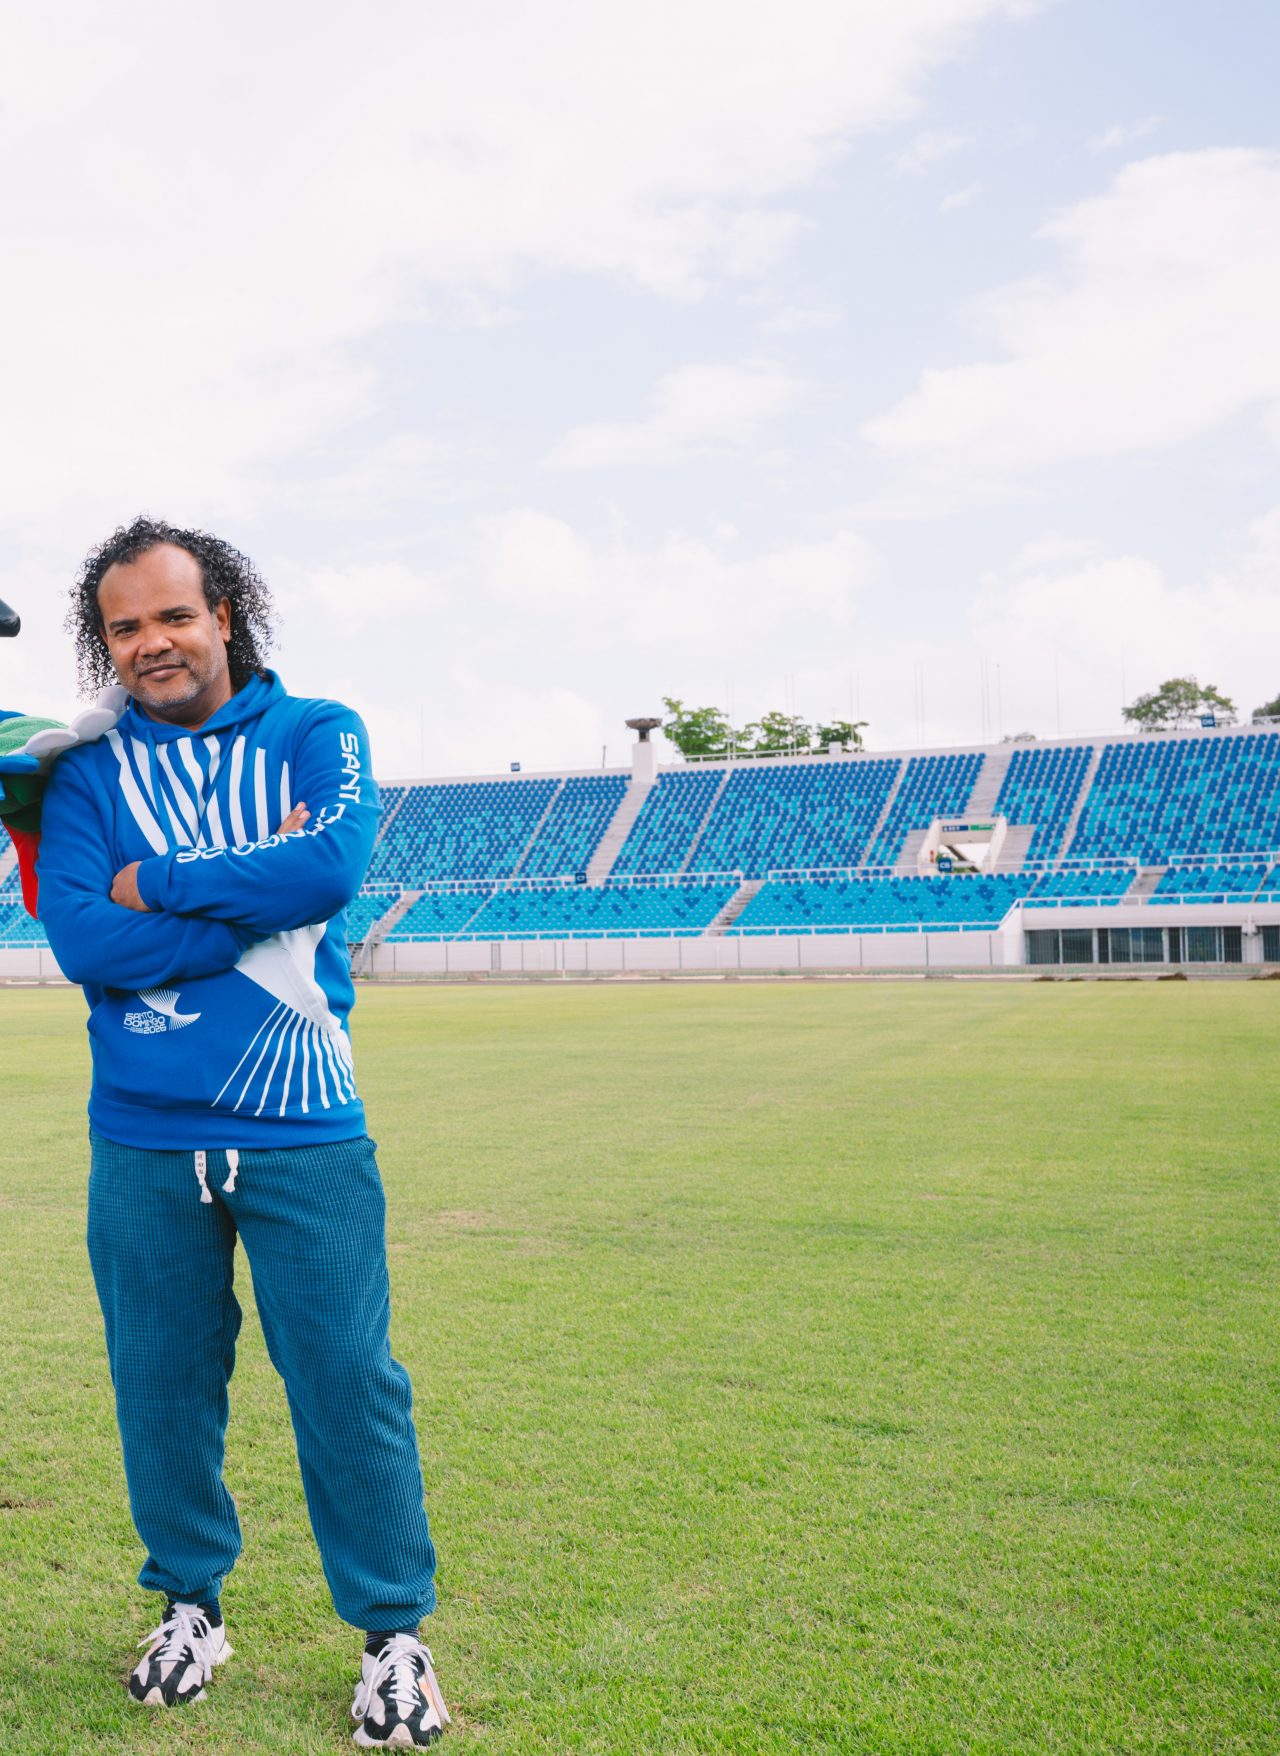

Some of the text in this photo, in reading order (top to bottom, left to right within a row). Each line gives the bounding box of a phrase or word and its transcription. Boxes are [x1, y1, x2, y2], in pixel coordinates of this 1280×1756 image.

[125, 1010, 154, 1021] SANTO
[123, 1015, 165, 1028] DOMINGO
[143, 1023, 167, 1034] 2026
